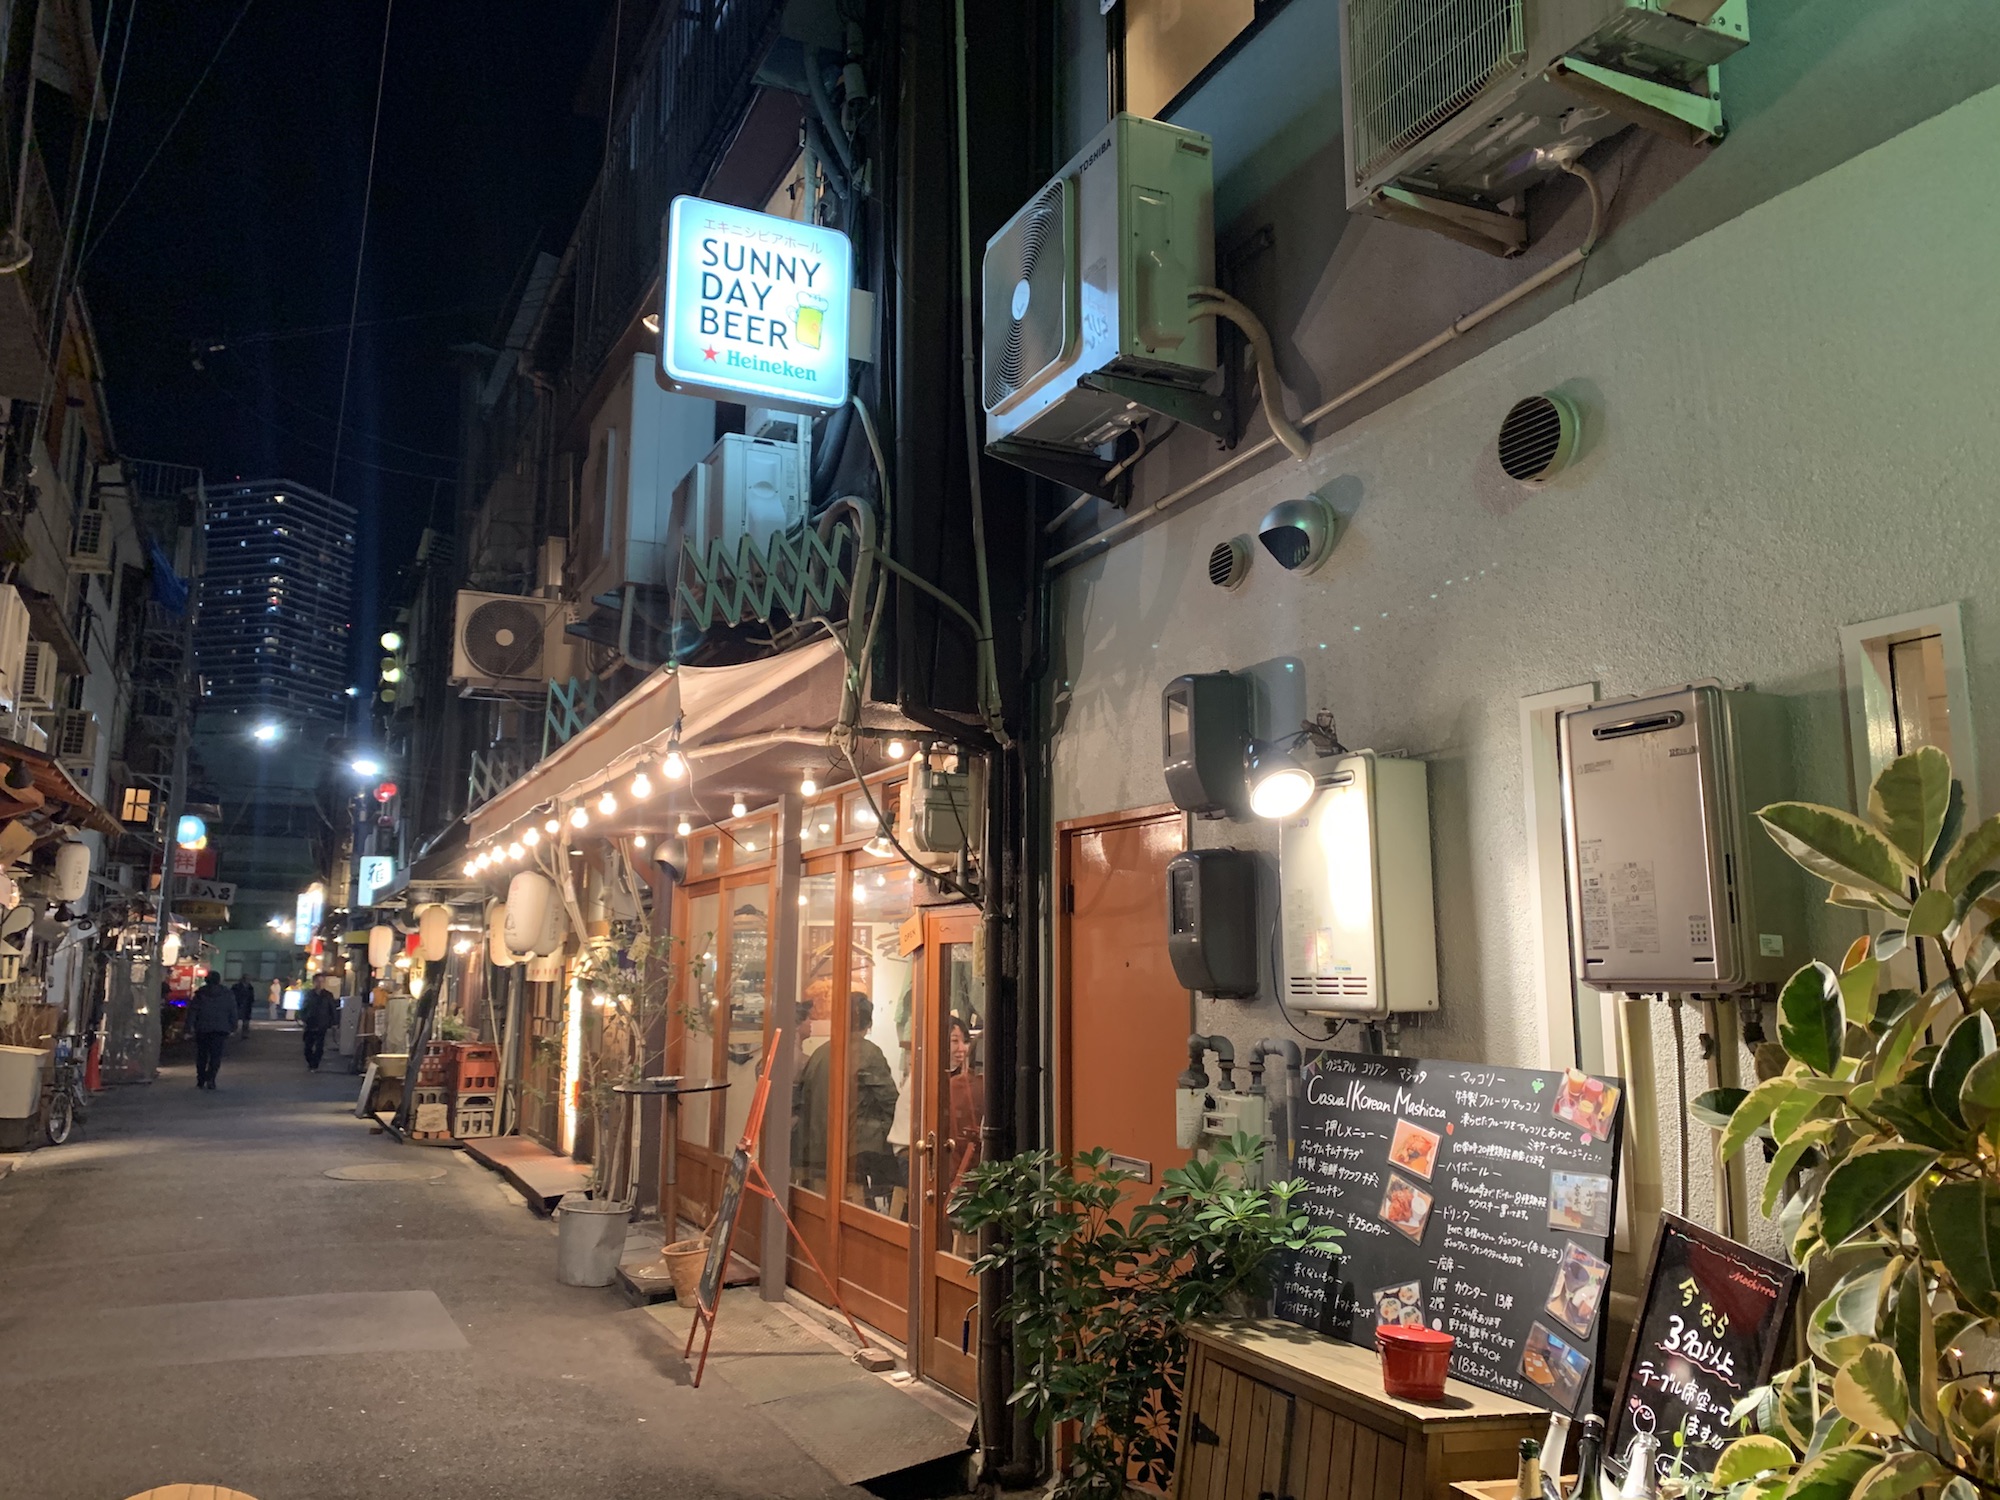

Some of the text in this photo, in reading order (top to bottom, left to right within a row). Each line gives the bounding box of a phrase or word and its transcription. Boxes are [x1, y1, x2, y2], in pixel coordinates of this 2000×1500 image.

[1079, 138, 1111, 174] TOSHIBA
[704, 218, 822, 254] エキニシビアホール
[702, 238, 821, 287] SUNNY
[702, 272, 772, 310] DAY
[700, 306, 788, 350] BEER
[727, 349, 817, 382] Heineken
[904, 928, 917, 943] OPEN
[1361, 1063, 1389, 1077] コリアン
[1398, 1067, 1428, 1085] マシッタ
[1307, 1075, 1447, 1119] Casual Korean Mashitta
[1455, 1281, 1487, 1300] カウンター
[1664, 1315, 1735, 1376] 3名以上
